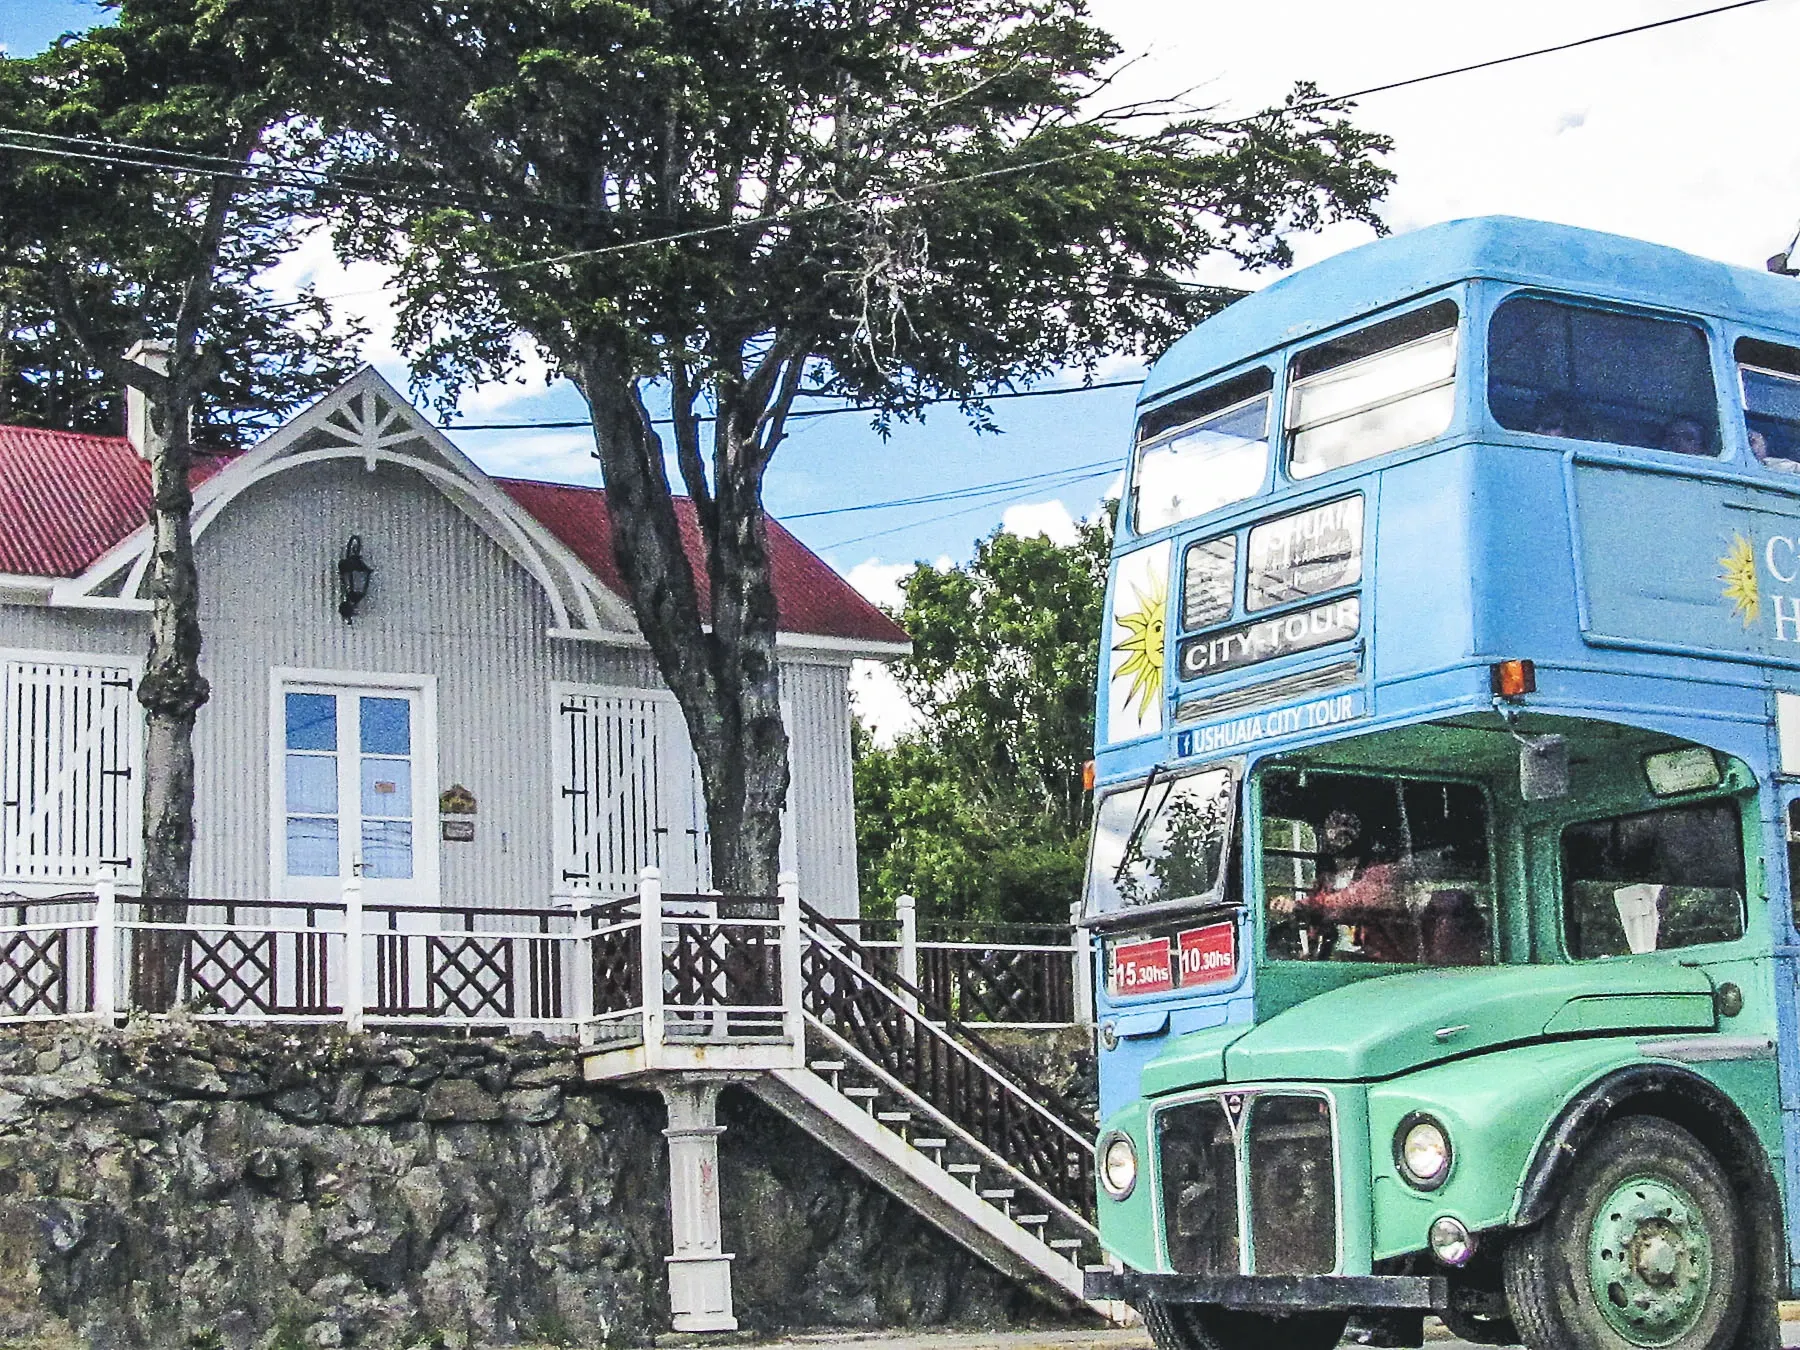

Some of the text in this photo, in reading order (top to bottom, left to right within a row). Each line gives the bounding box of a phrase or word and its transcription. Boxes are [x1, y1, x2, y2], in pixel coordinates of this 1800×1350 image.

[1184, 601, 1358, 671] CITY TOUR
[1194, 716, 1264, 752] USHUAIA
[1266, 707, 1303, 737] CITY
[1306, 695, 1352, 726] TOUR
[1116, 961, 1169, 987] 15.30hs
[1181, 948, 1231, 974] 10.30hs
